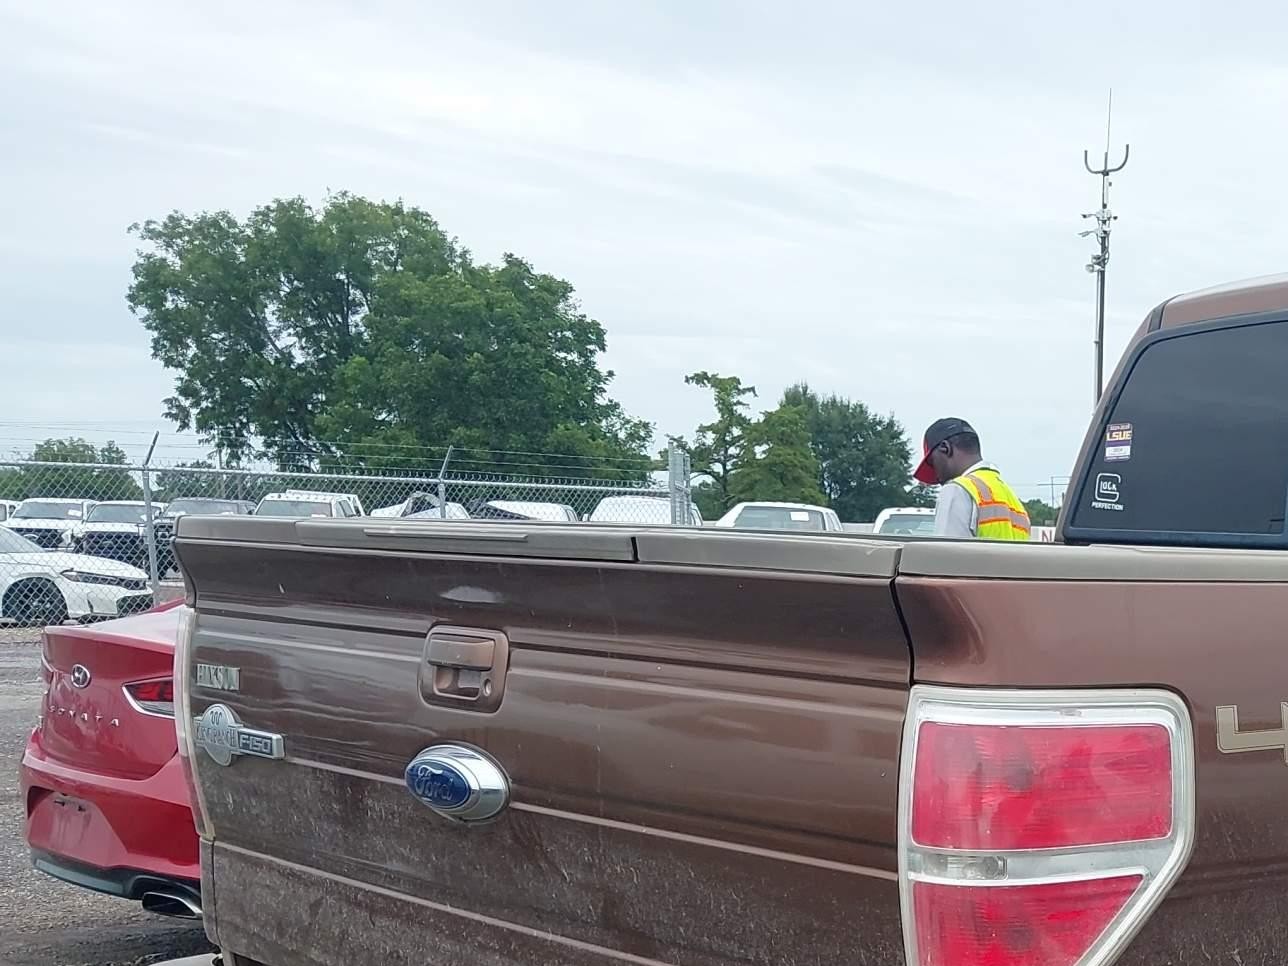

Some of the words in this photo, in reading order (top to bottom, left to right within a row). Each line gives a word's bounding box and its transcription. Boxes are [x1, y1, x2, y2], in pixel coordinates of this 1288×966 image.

[1092, 501, 1124, 511] PERFECTION
[49, 705, 119, 726] SONATA
[240, 734, 271, 753] F-150
[414, 764, 454, 801] Ford
